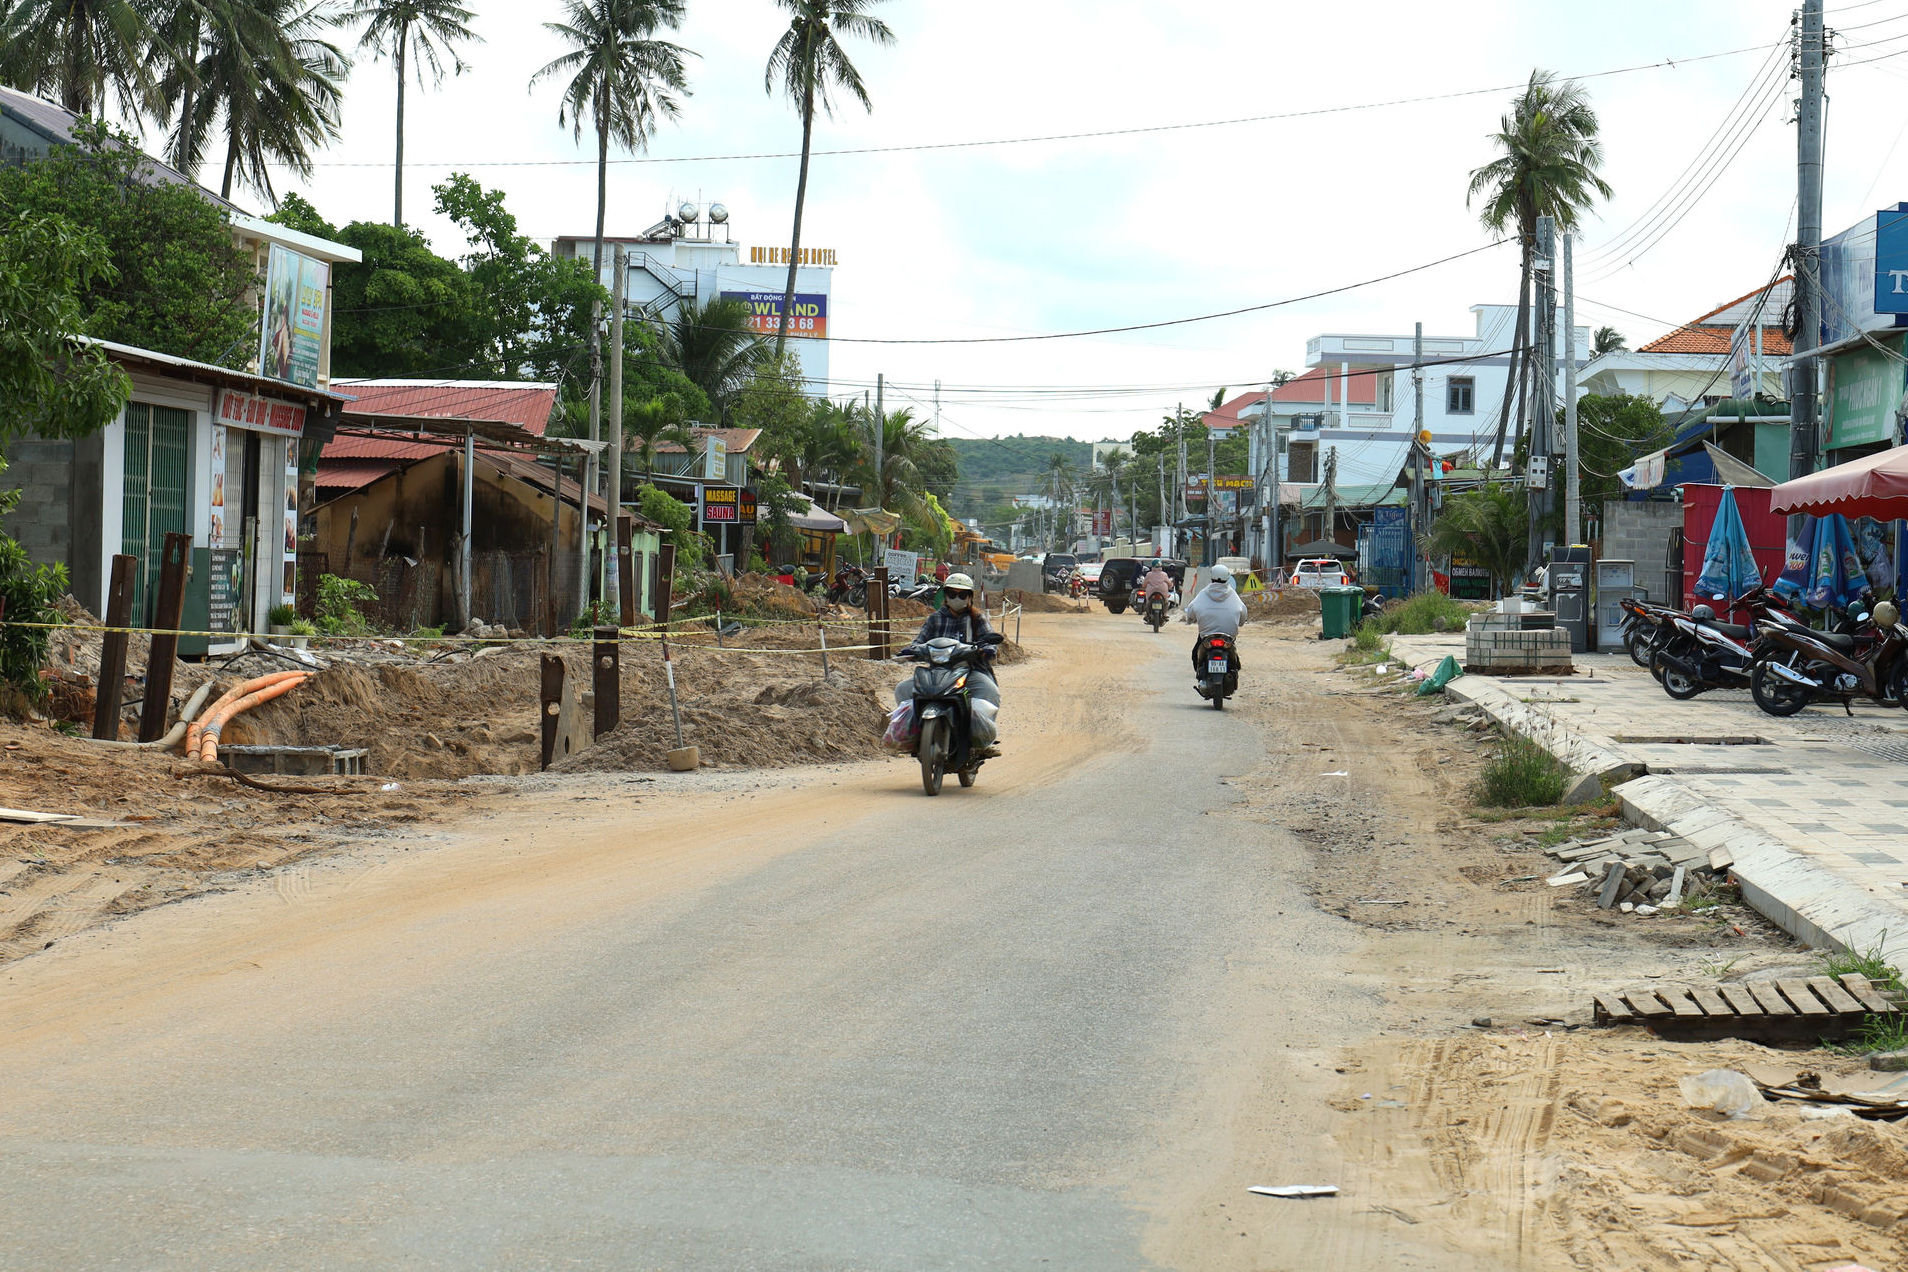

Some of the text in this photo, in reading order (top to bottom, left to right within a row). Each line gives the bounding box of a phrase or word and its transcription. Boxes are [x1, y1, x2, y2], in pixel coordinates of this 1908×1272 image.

[781, 248, 808, 265] BECH
[811, 249, 838, 265] HOTEL
[800, 318, 814, 330] 68
[705, 490, 736, 502] MASSAGE
[707, 507, 735, 519] SAUNA
[1452, 568, 1468, 576] ОБМЕН
